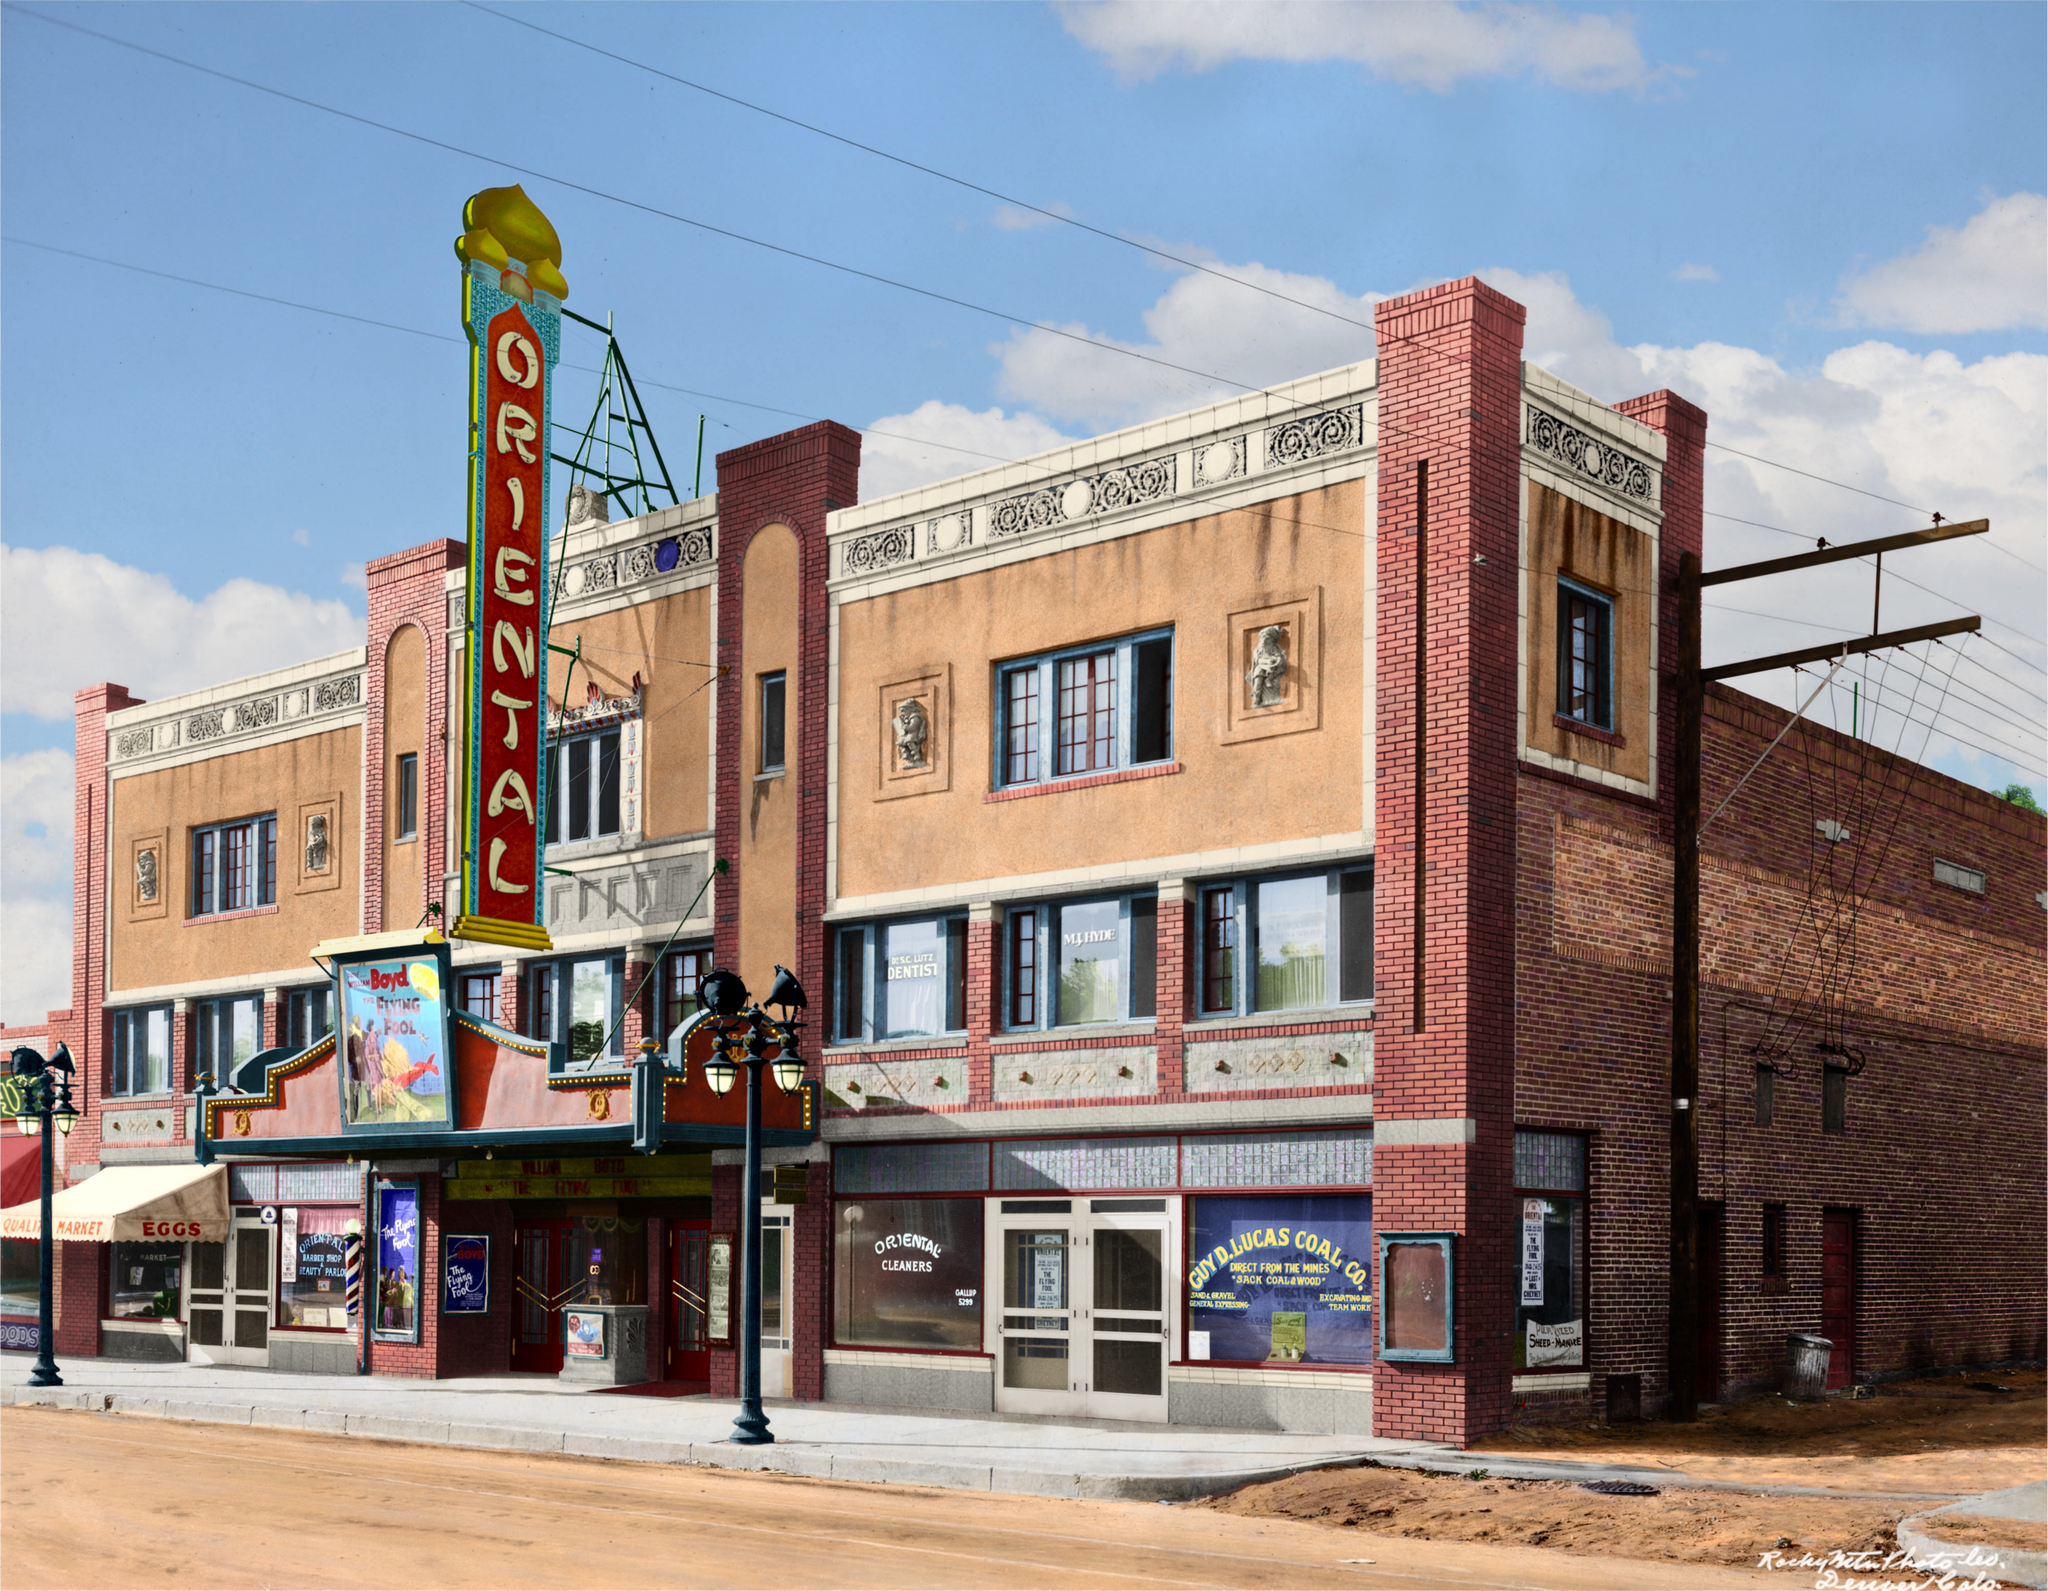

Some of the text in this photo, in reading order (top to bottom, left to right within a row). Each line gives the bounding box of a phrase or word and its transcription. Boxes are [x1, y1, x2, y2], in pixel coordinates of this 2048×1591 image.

[488, 329, 541, 894] ORIENTAL
[1084, 929, 1116, 944] HYDE
[913, 953, 934, 963] LUTZ
[370, 963, 410, 993] Boyd
[888, 963, 937, 980] DENTIST
[363, 996, 420, 1017] THE FLYING
[384, 1018, 417, 1036] FOOL
[521, 1158, 625, 1175] WILLIAM BOYD
[555, 1180, 591, 1196] FLYING
[56, 1221, 103, 1236] MARKET
[143, 1222, 201, 1237] EGGS
[381, 1224, 396, 1240] The
[299, 1232, 344, 1254] ORIENTAL
[393, 1231, 415, 1252] Fool
[874, 1232, 942, 1259] ORIENTAL
[140, 1254, 167, 1262] MARKET
[302, 1254, 342, 1263] BARBER SHOP
[457, 1250, 485, 1260] BOYD
[1189, 1227, 1367, 1292] GUY D. LUCAS COAL CO.
[299, 1267, 322, 1276] BEAUTY
[449, 1265, 466, 1276] The
[881, 1260, 933, 1272] CLEANERS
[1230, 1263, 1330, 1274] DIRECT FROM THE MINES
[447, 1272, 473, 1289] Flying
[955, 1289, 977, 1297] GALLUP
[1211, 1292, 1236, 1300] GRAVEL
[958, 1298, 974, 1306] 5299
[1189, 1300, 1214, 1308] GENERAL
[1328, 1303, 1372, 1312] TEAM WORK
